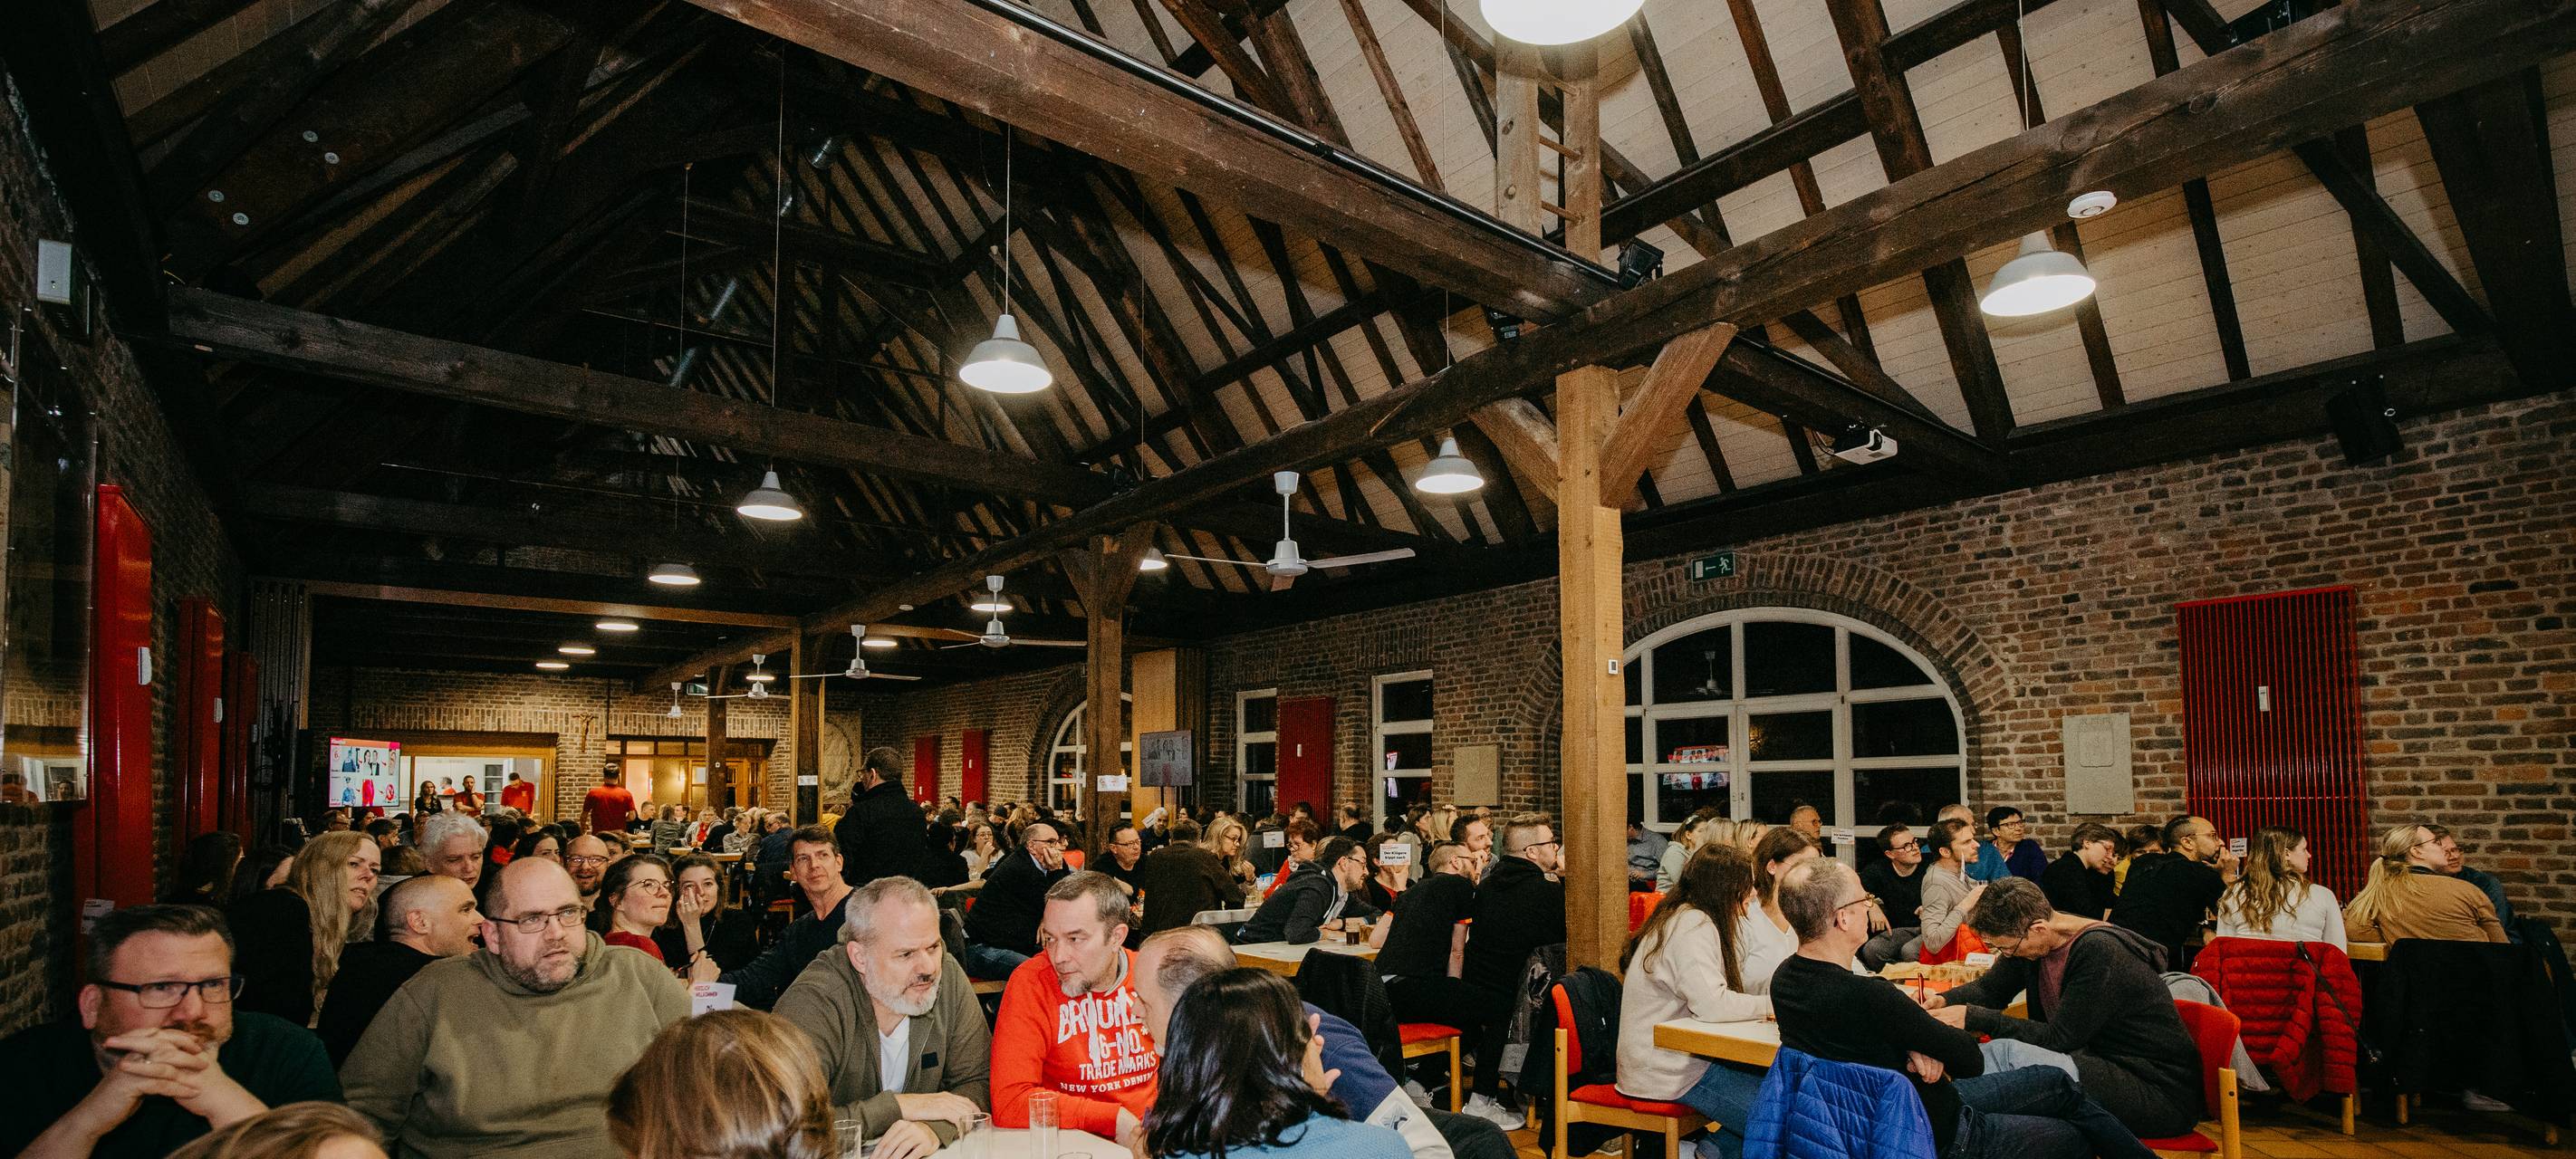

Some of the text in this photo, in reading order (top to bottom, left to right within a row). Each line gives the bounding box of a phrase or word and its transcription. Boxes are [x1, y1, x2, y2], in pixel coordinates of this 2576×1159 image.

[1079, 1050, 1157, 1081] TRADE MARKS
[1060, 1071, 1153, 1093] NEW YORK DENIM
